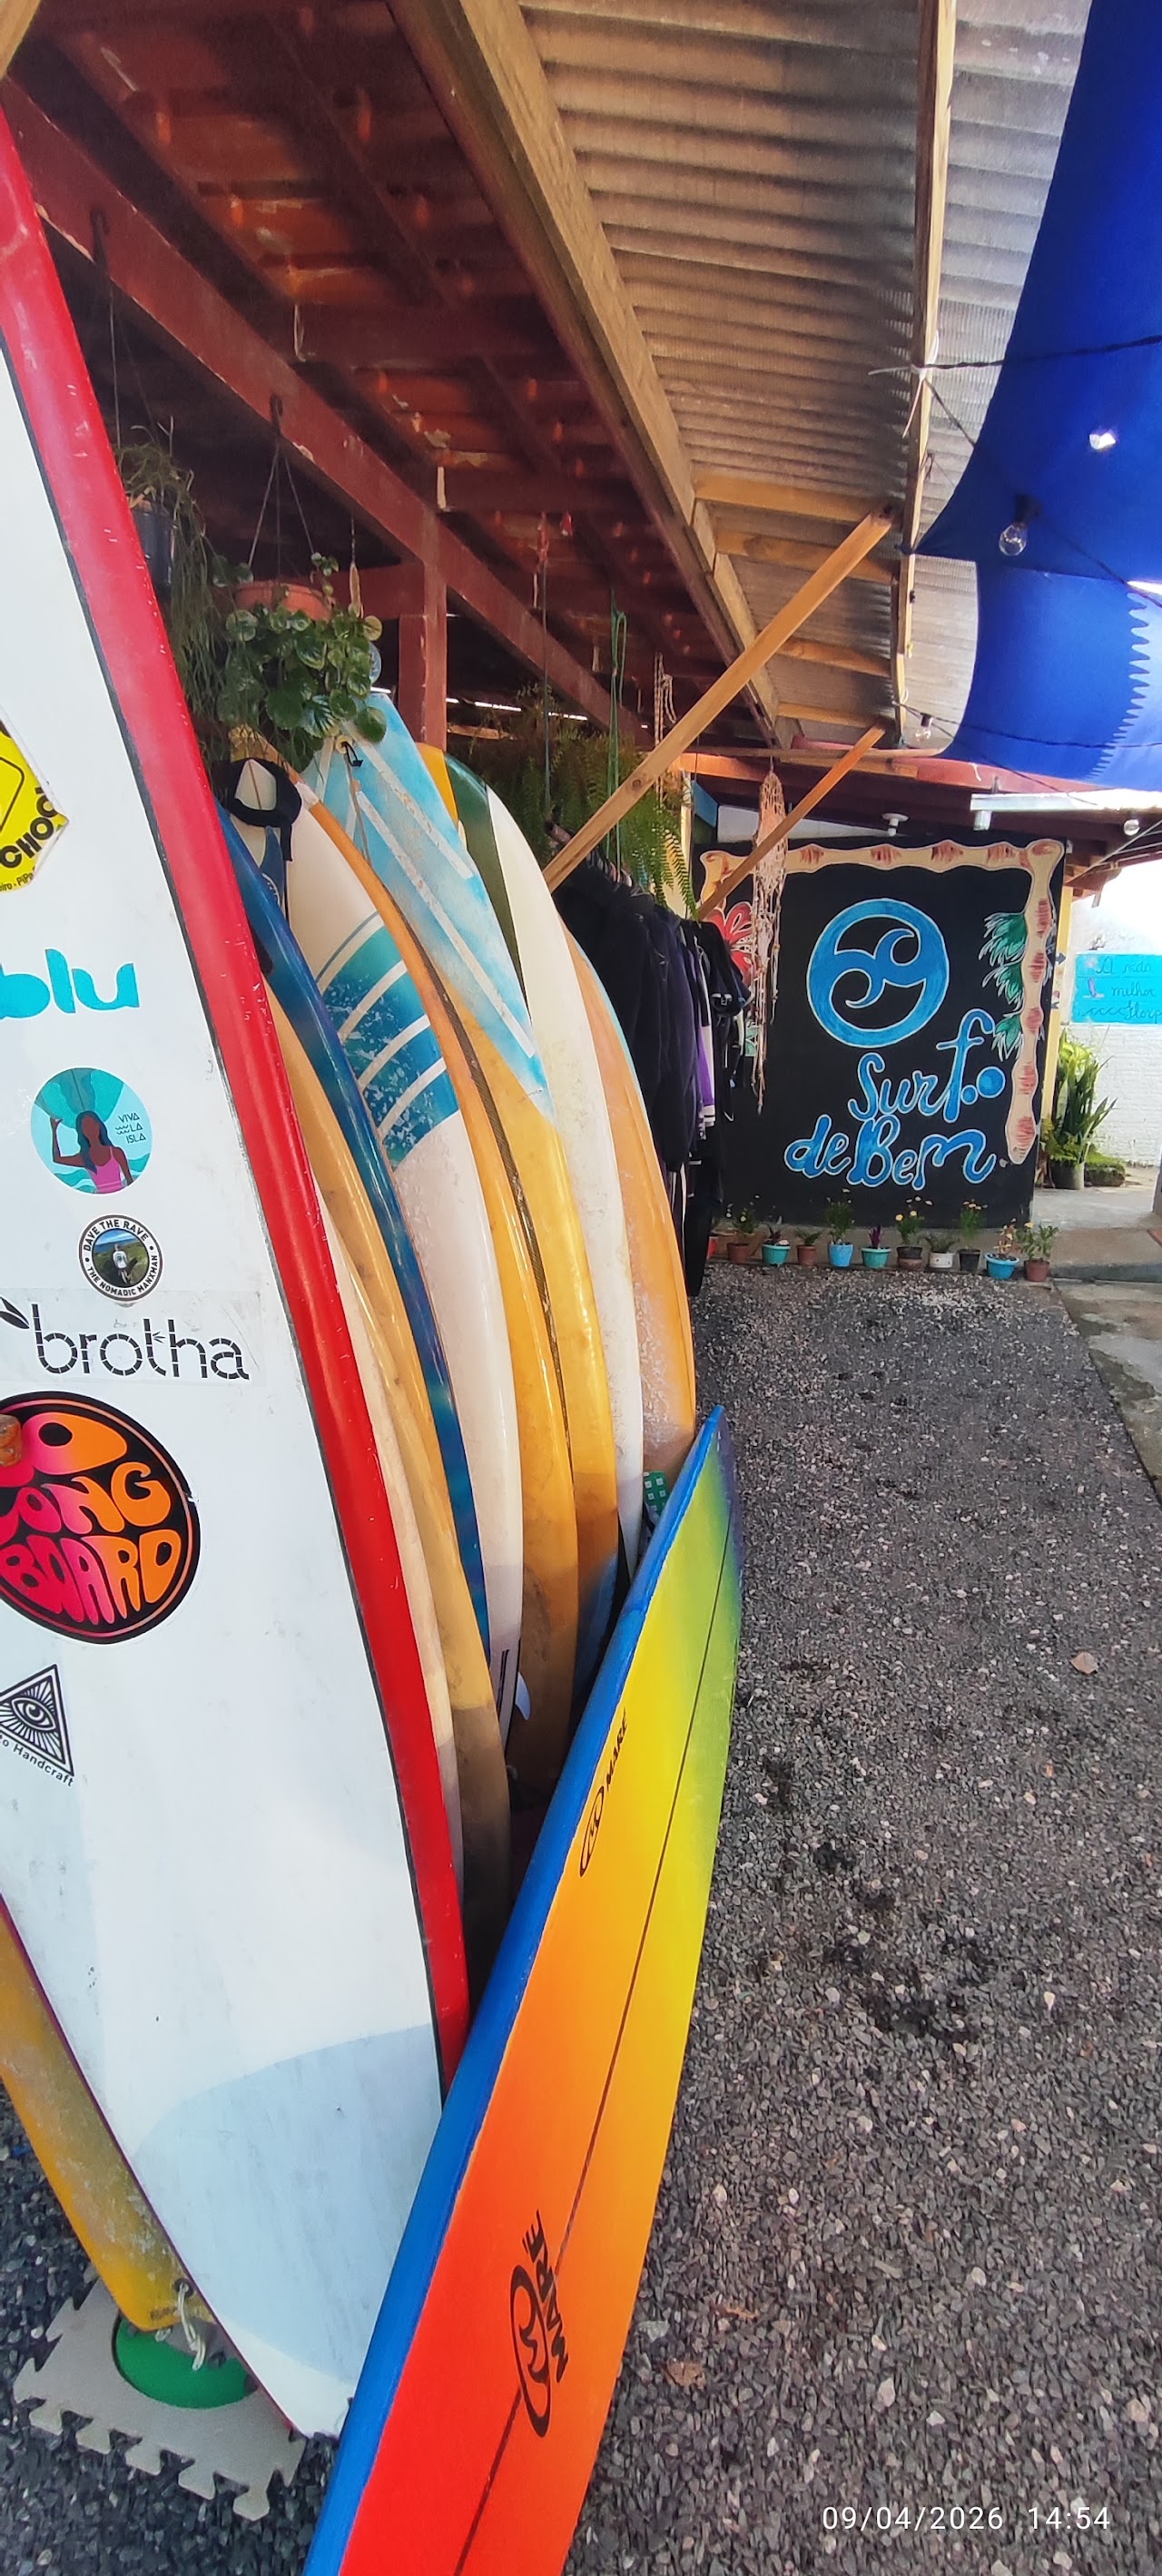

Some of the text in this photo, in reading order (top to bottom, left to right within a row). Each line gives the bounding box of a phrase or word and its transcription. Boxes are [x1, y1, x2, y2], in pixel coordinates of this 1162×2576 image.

[0, 786, 59, 869] CHOO
[848, 1008, 997, 1123] Surf
[118, 1112, 141, 1123] VIVA
[125, 1132, 147, 1144] ISLA
[129, 1122, 143, 1132] LA
[783, 1114, 997, 1190] de Bem
[83, 1219, 149, 1252] DAVE THE RAVE
[87, 1254, 159, 1296] THE NOMADIC MANXMAN
[31, 1303, 250, 1380] brotha
[0, 1529, 182, 1625] BOARD
[13, 1744, 74, 1786] Handcraft
[522, 2208, 569, 2384] MARE
